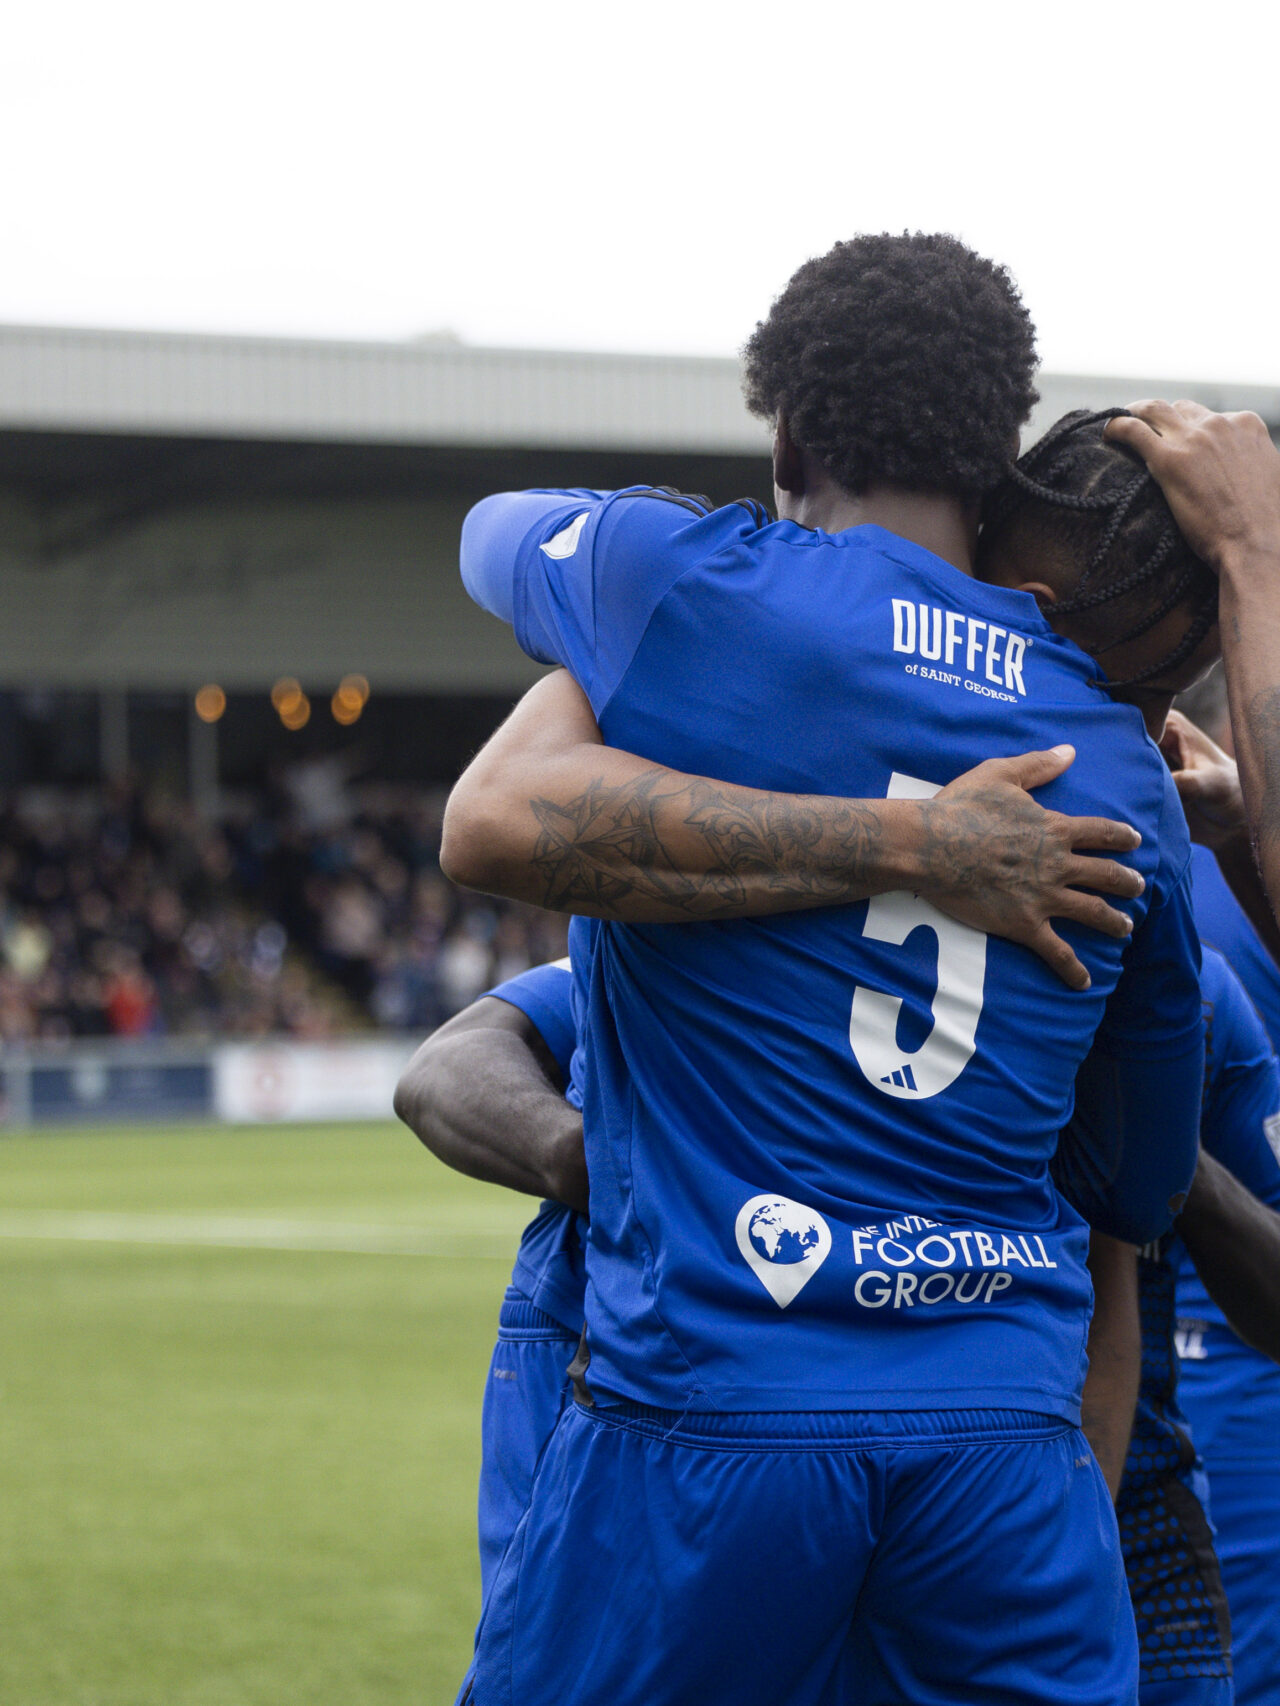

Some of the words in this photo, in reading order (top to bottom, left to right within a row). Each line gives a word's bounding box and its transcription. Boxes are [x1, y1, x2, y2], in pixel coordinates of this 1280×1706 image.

[904, 664, 918, 676] of
[920, 666, 961, 687] SAINT
[964, 679, 1018, 704] GEORGE
[885, 1215, 943, 1240] INTE
[852, 1230, 1058, 1268] FOOTBALL
[854, 1270, 1012, 1309] GROUP
